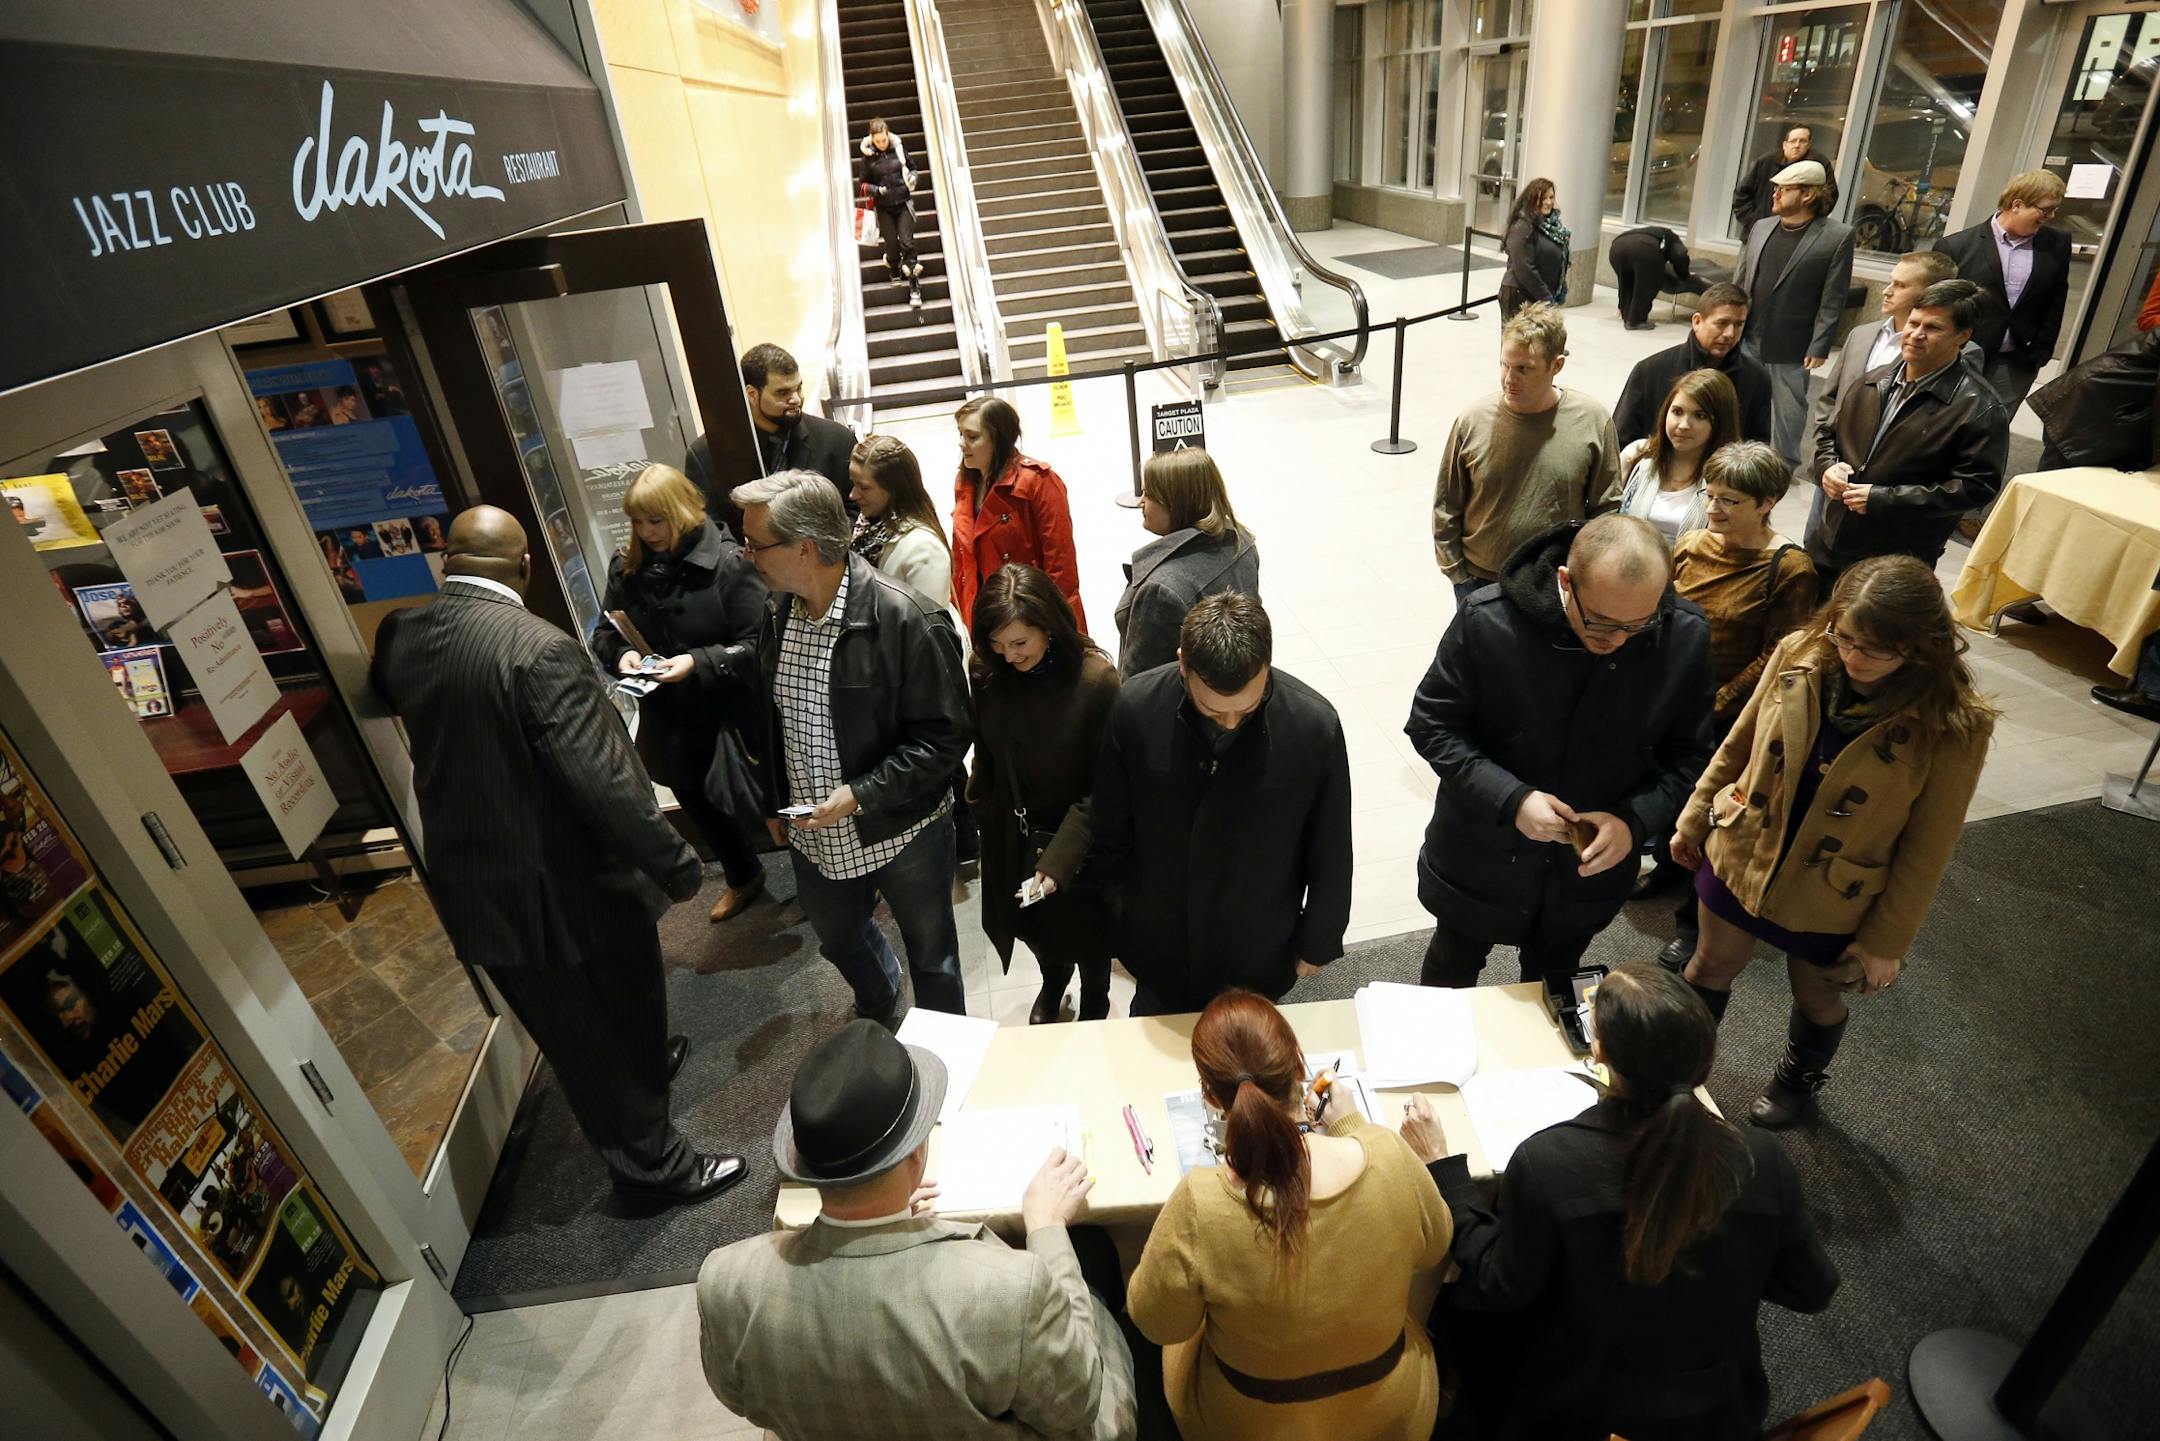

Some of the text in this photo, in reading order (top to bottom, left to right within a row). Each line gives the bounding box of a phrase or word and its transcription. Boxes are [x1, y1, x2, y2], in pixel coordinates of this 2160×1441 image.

[292, 79, 506, 240] dakota
[503, 149, 561, 184] RESTAURANT
[73, 181, 256, 257] JAZZ CLUB
[1156, 407, 1199, 418] TARGET PLAZA
[1159, 416, 1200, 436] CAUTION
[386, 484, 443, 506] dakota
[145, 571, 166, 587] THANK
[190, 616, 228, 648] Positively
[211, 640, 225, 653] No
[264, 770, 279, 785] No
[278, 747, 300, 772] Audio
[282, 760, 306, 788] Visual
[279, 774, 316, 816] Recording
[22, 828, 38, 844] FEB
[74, 1032, 140, 1106] Charlie
[131, 986, 175, 1039] Mars
[179, 1047, 215, 1096] Bamako
[140, 1134, 167, 1171] Eric
[165, 1096, 196, 1134] Bibb
[194, 1077, 208, 1096] &
[158, 1115, 199, 1166] Habib
[301, 1303, 330, 1361] harlie
[321, 1255, 355, 1307] Mars
